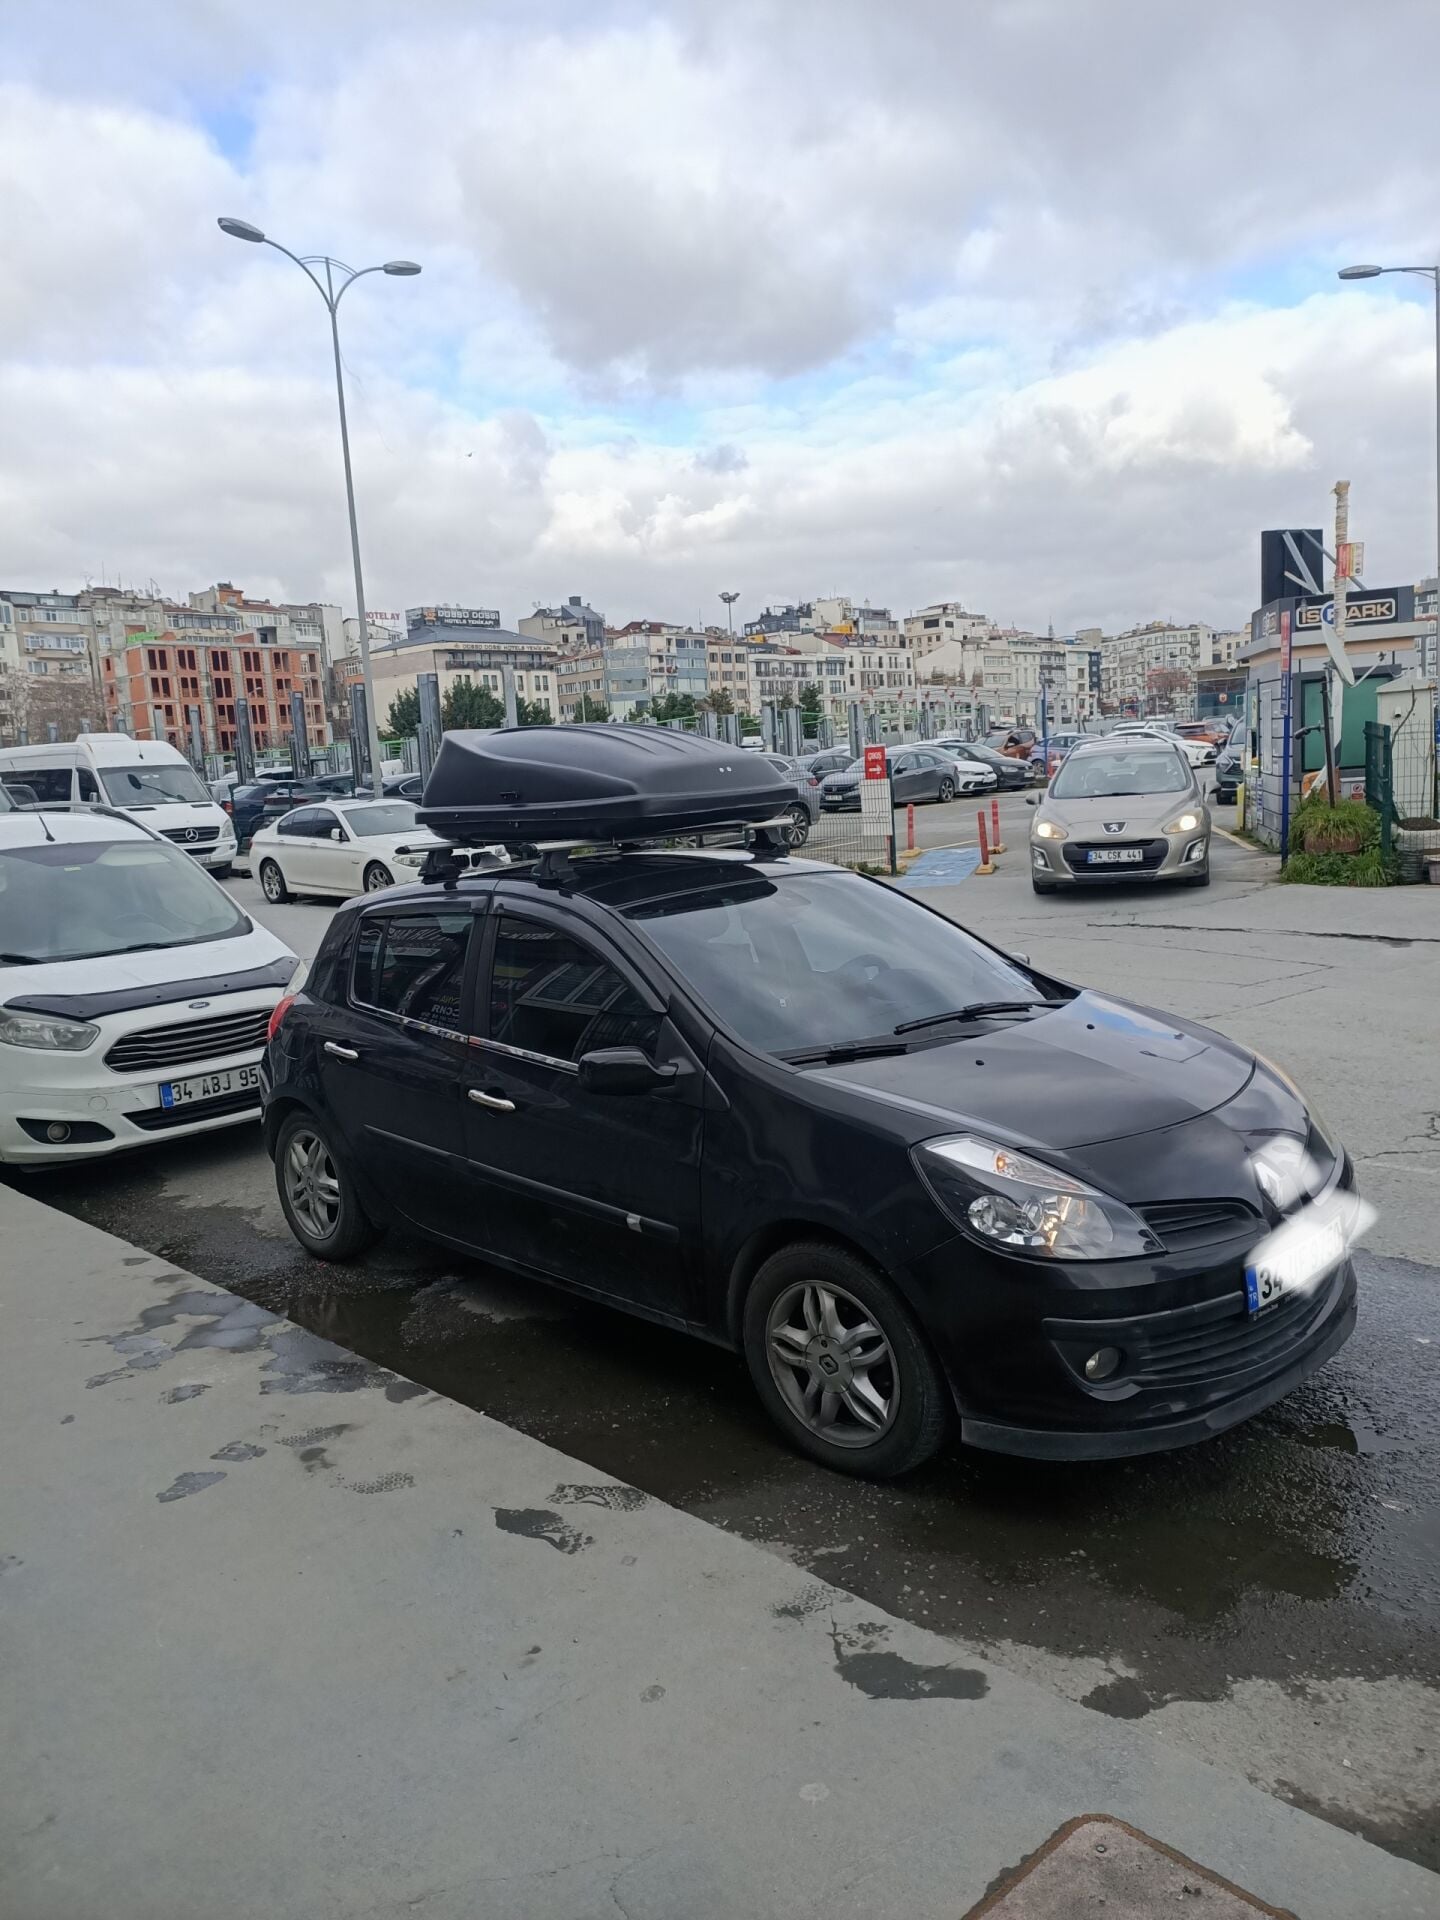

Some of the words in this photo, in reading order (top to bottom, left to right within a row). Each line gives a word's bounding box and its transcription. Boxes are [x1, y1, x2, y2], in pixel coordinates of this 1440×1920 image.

[390, 612, 400, 621] AY
[1093, 851, 1102, 859] 34
[1127, 850, 1141, 859] 441
[172, 1082, 193, 1102] 34
[202, 1073, 231, 1097] ABJ
[239, 1067, 259, 1087] 95
[1260, 1266, 1283, 1300] 34
[1249, 1292, 1258, 1306] TR
